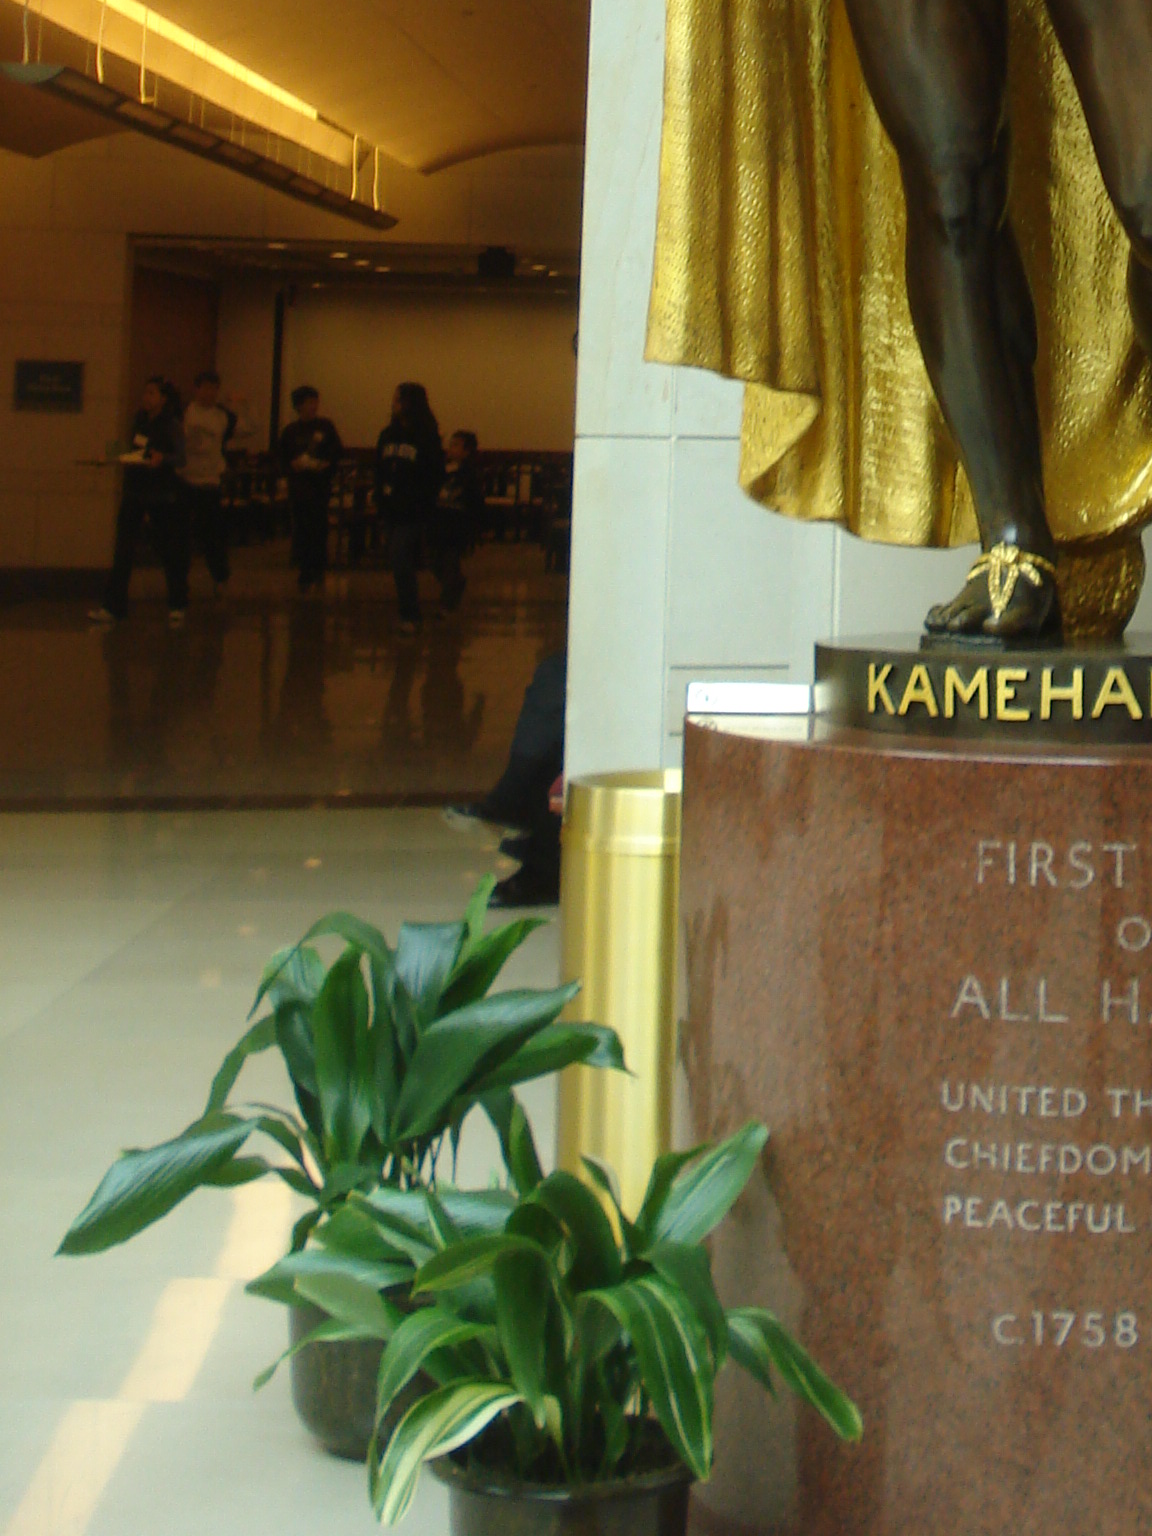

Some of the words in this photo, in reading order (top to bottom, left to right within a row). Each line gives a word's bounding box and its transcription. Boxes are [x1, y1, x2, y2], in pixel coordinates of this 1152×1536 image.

[976, 840, 1136, 889] FIRST
[951, 974, 1069, 1023] ALL
[941, 1081, 1087, 1117] UNITED
[943, 1195, 1135, 1233] PEACEFUL
